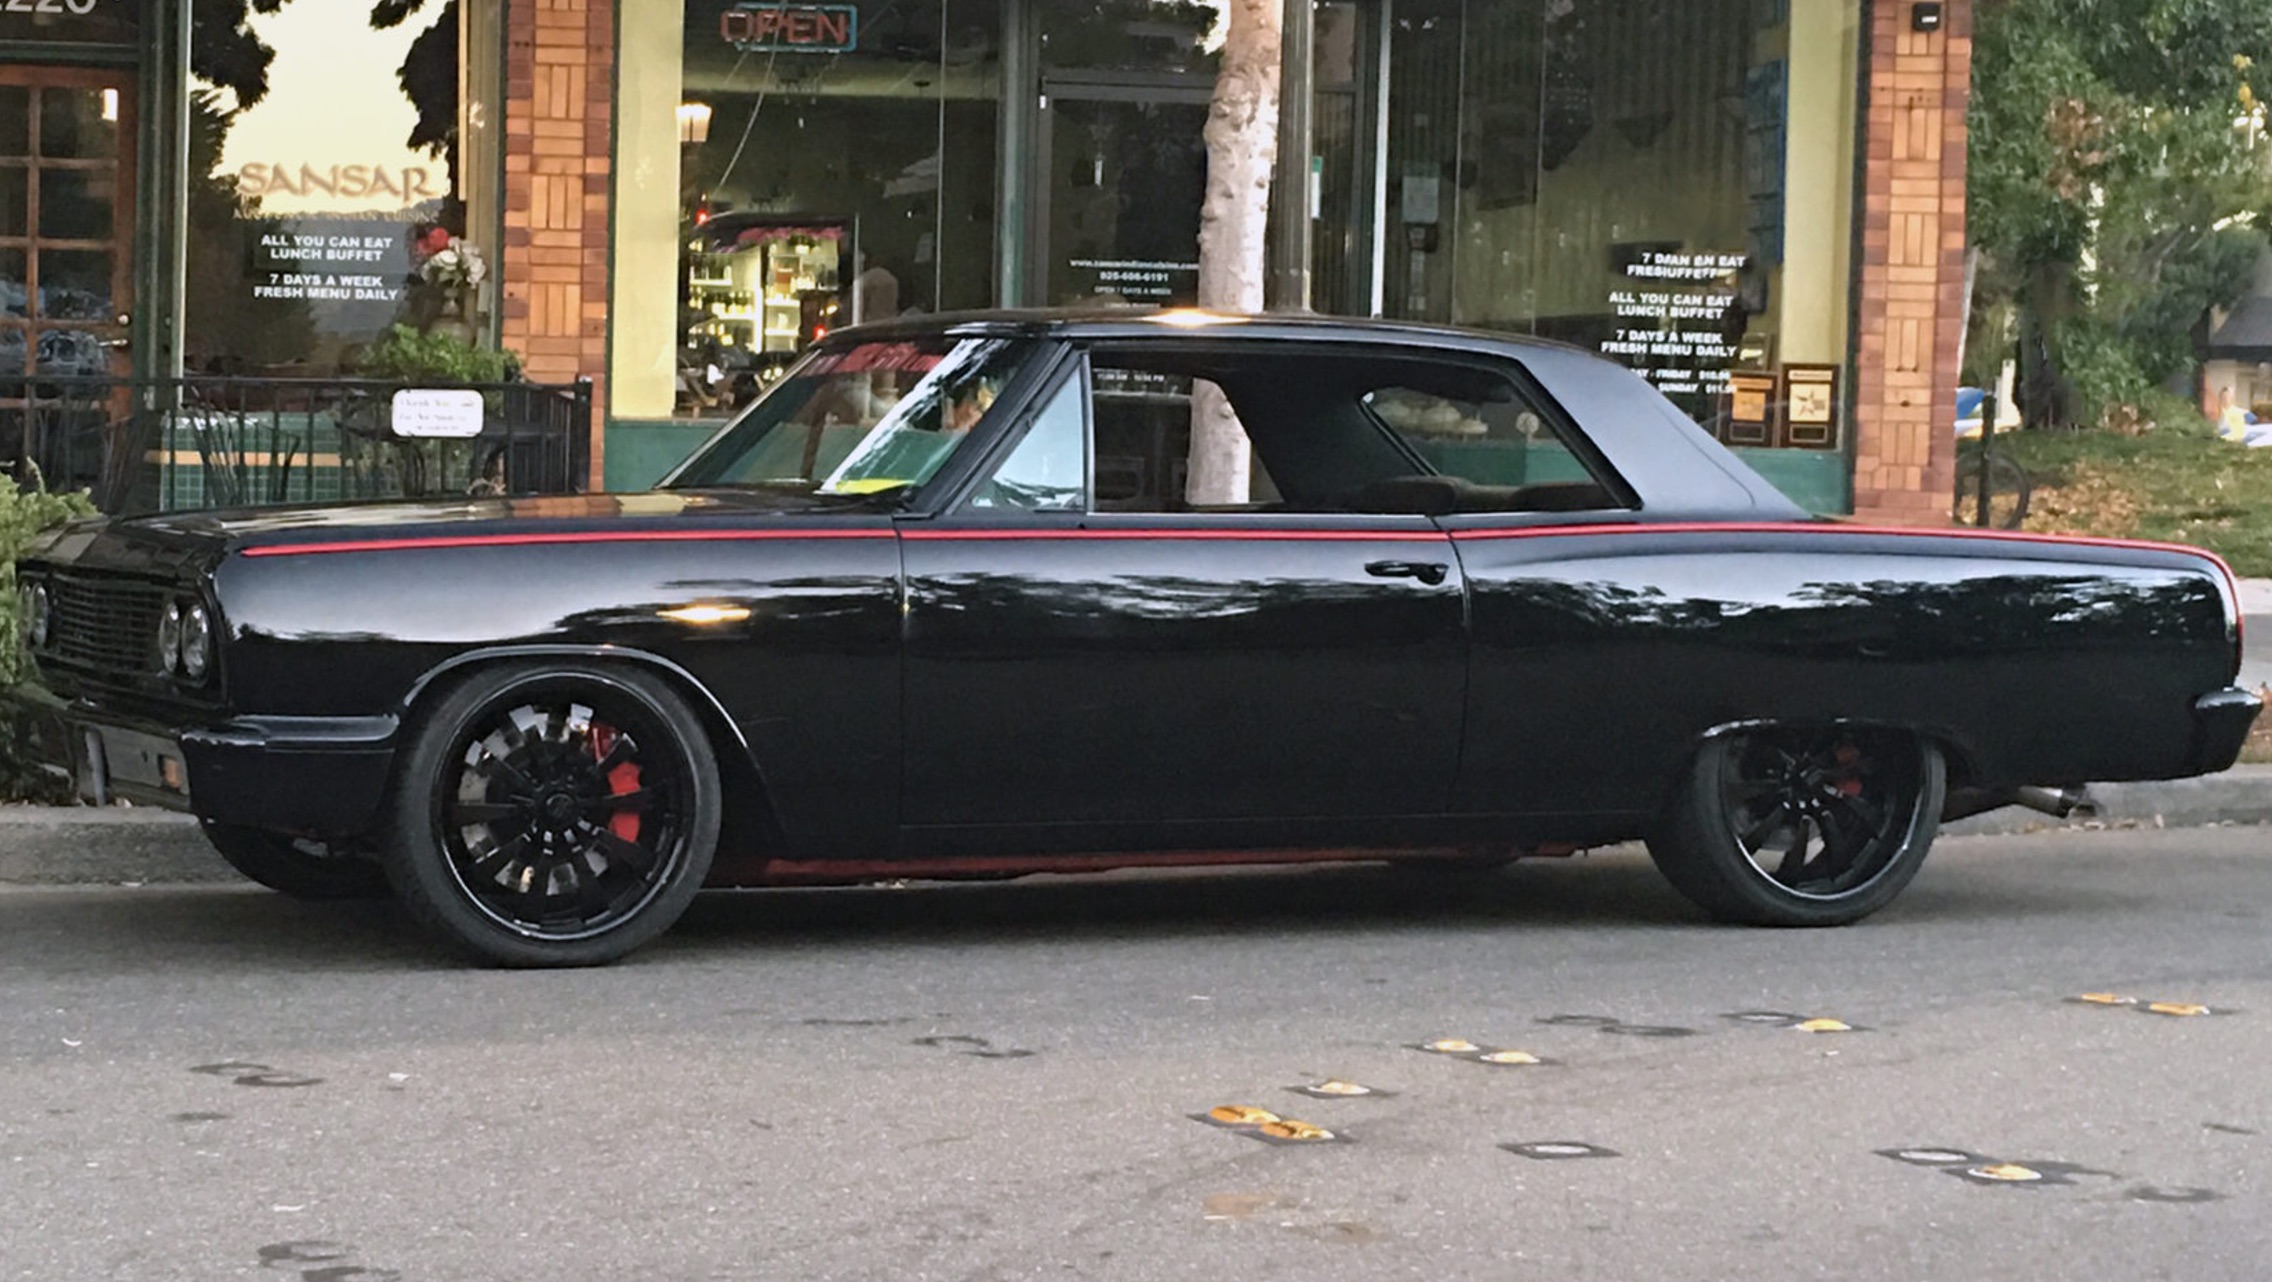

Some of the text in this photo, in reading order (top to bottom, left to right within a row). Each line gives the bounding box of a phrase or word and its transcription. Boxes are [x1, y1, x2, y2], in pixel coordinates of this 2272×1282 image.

[721, 9, 847, 44] OPEN
[238, 162, 439, 206] SANSAR
[261, 234, 393, 248] ALL YOU CAN EAT
[270, 248, 383, 261] LUNCH BUFFET
[1642, 252, 1651, 264] 7
[1718, 256, 1746, 267] EAT
[269, 273, 383, 287] 7 DAYS A WEEK
[254, 286, 398, 300] FRESH MENU DAILY
[1609, 291, 1734, 307] ALL YOU CAN EAT
[1617, 305, 1724, 319] LUNCH BUFFET
[1616, 329, 1723, 344] 7 DAYS A WEEK
[1601, 341, 1737, 357] FRESH MENU DAILY
[1655, 368, 1692, 379] FRIDAY
[1658, 382, 1699, 393] SUNDAY
